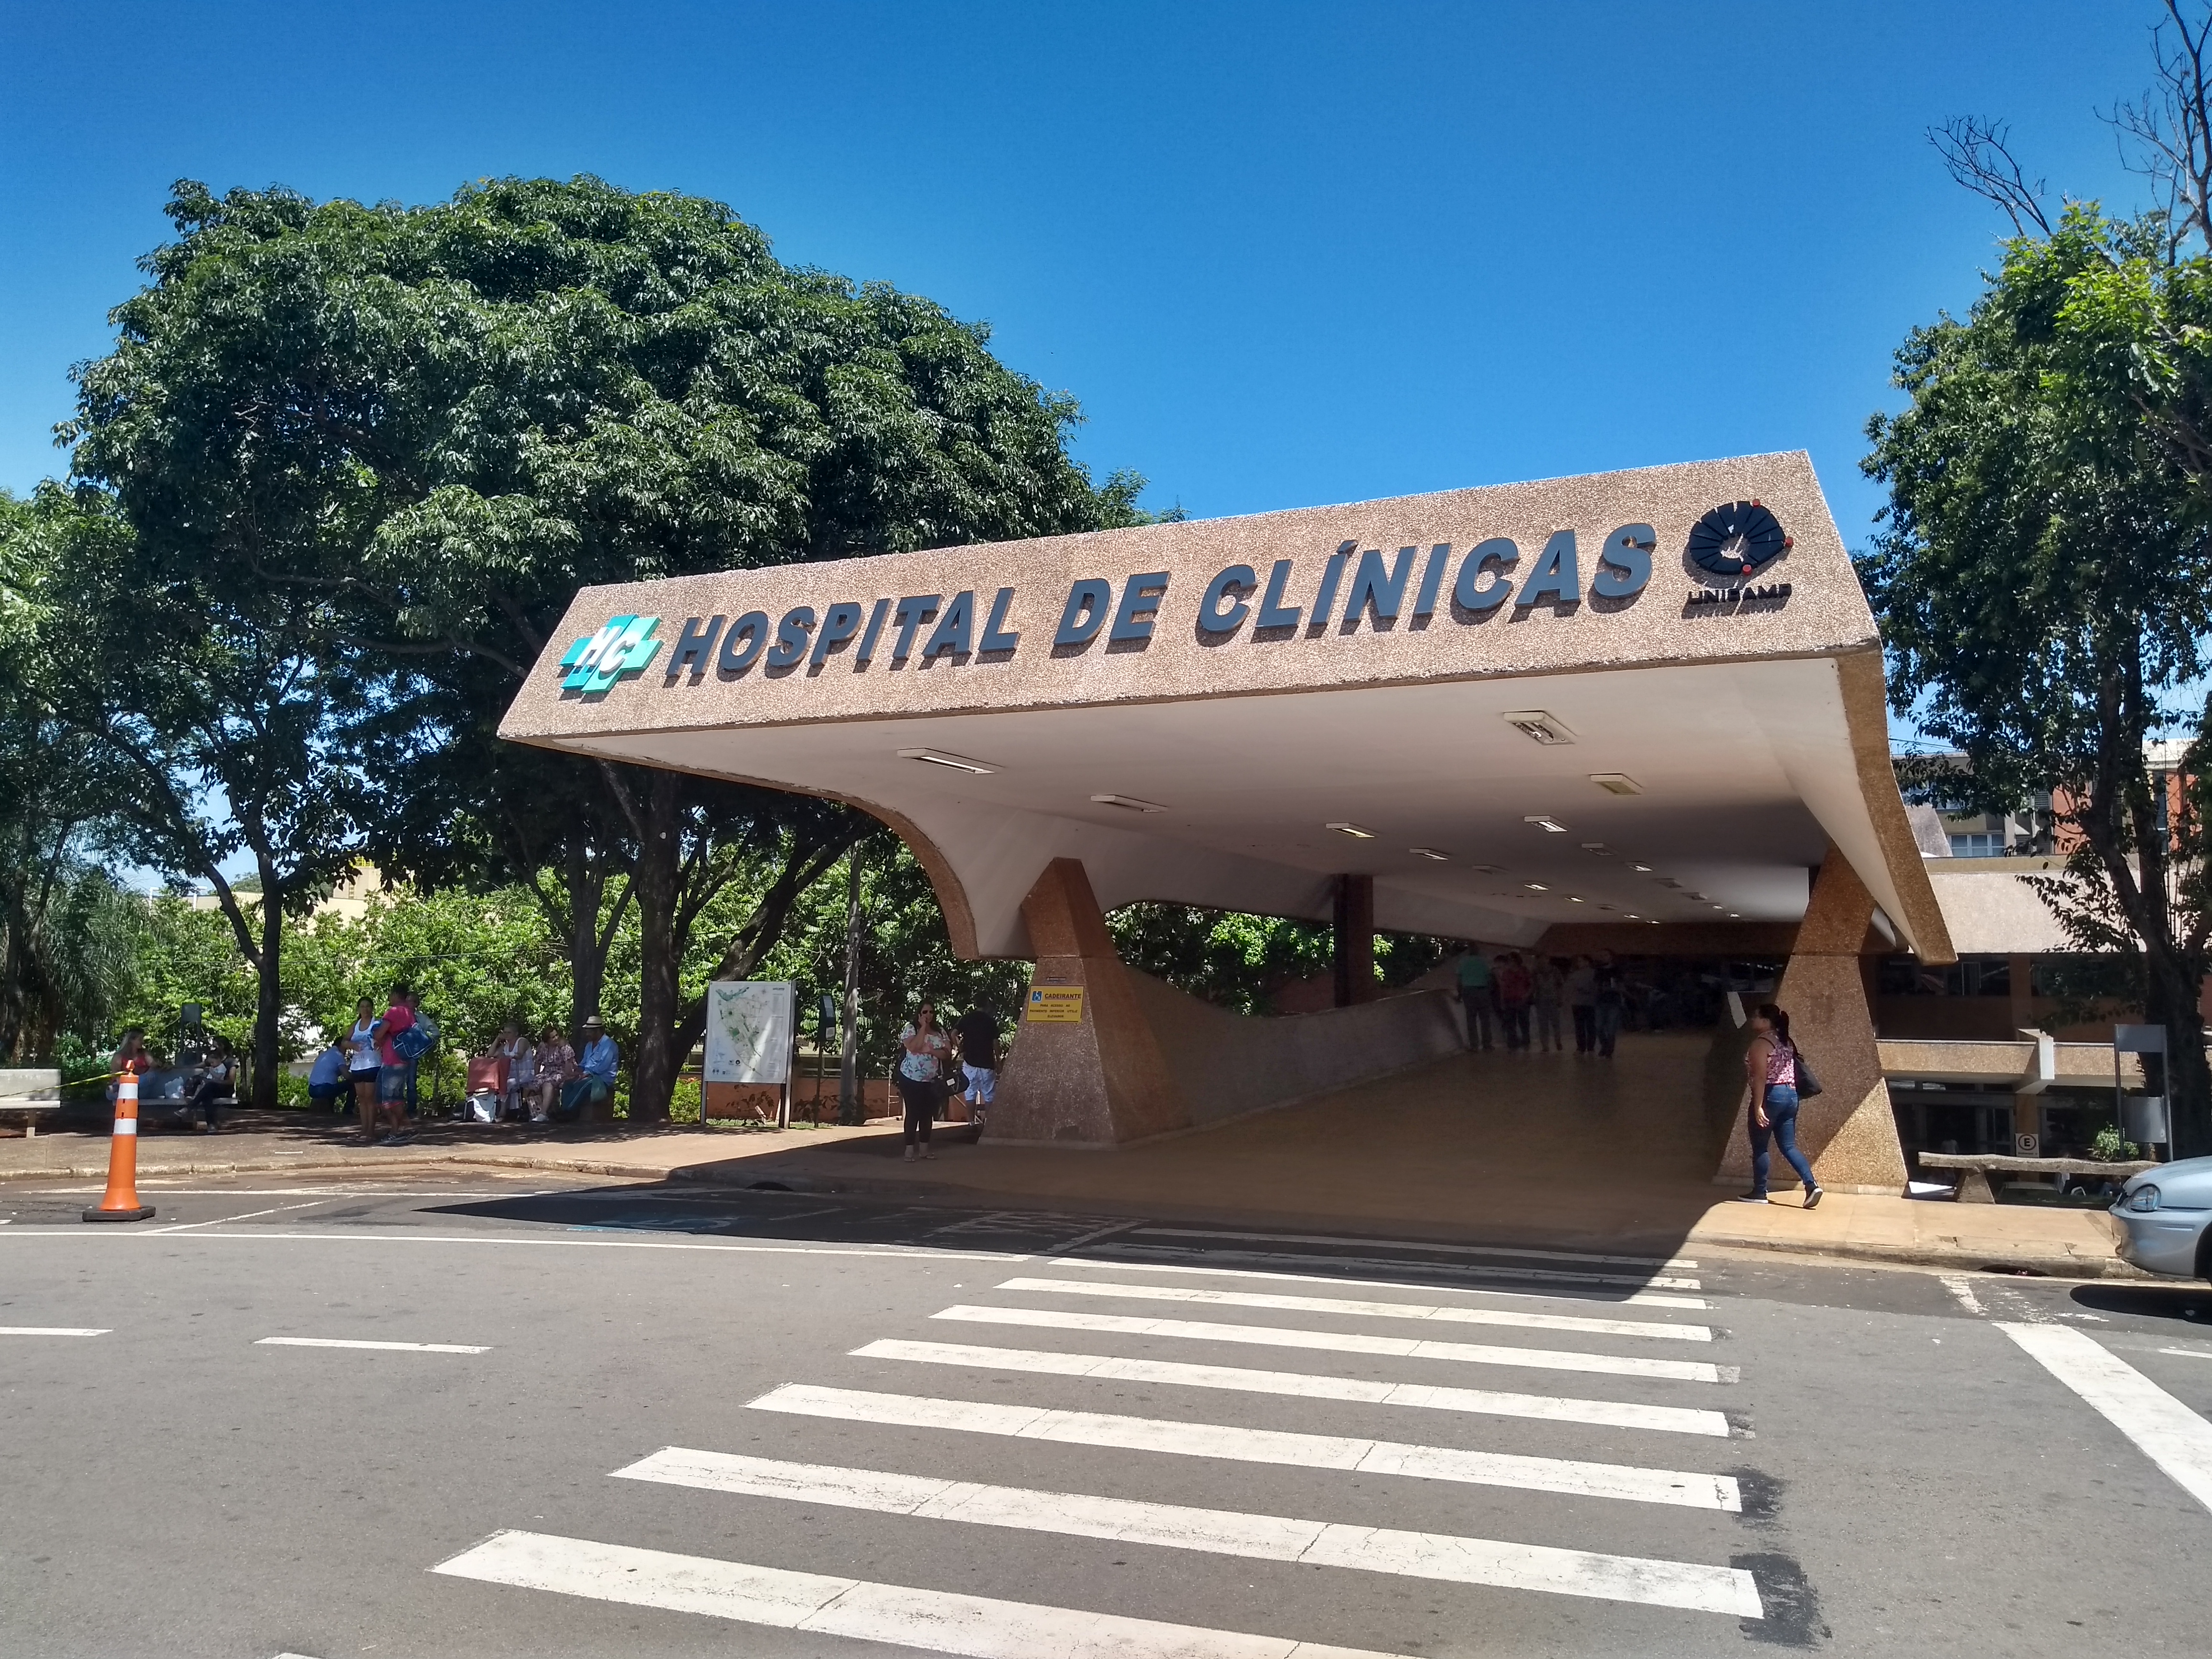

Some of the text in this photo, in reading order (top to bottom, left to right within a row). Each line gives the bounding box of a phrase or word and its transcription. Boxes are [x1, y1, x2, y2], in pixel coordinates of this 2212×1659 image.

[669, 523, 1657, 677] HOSPITAL DE CLÍNICAS
[1688, 583, 1792, 605] UNICAMP
[573, 625, 641, 673] HC
[2024, 1138, 2030, 1147] E
